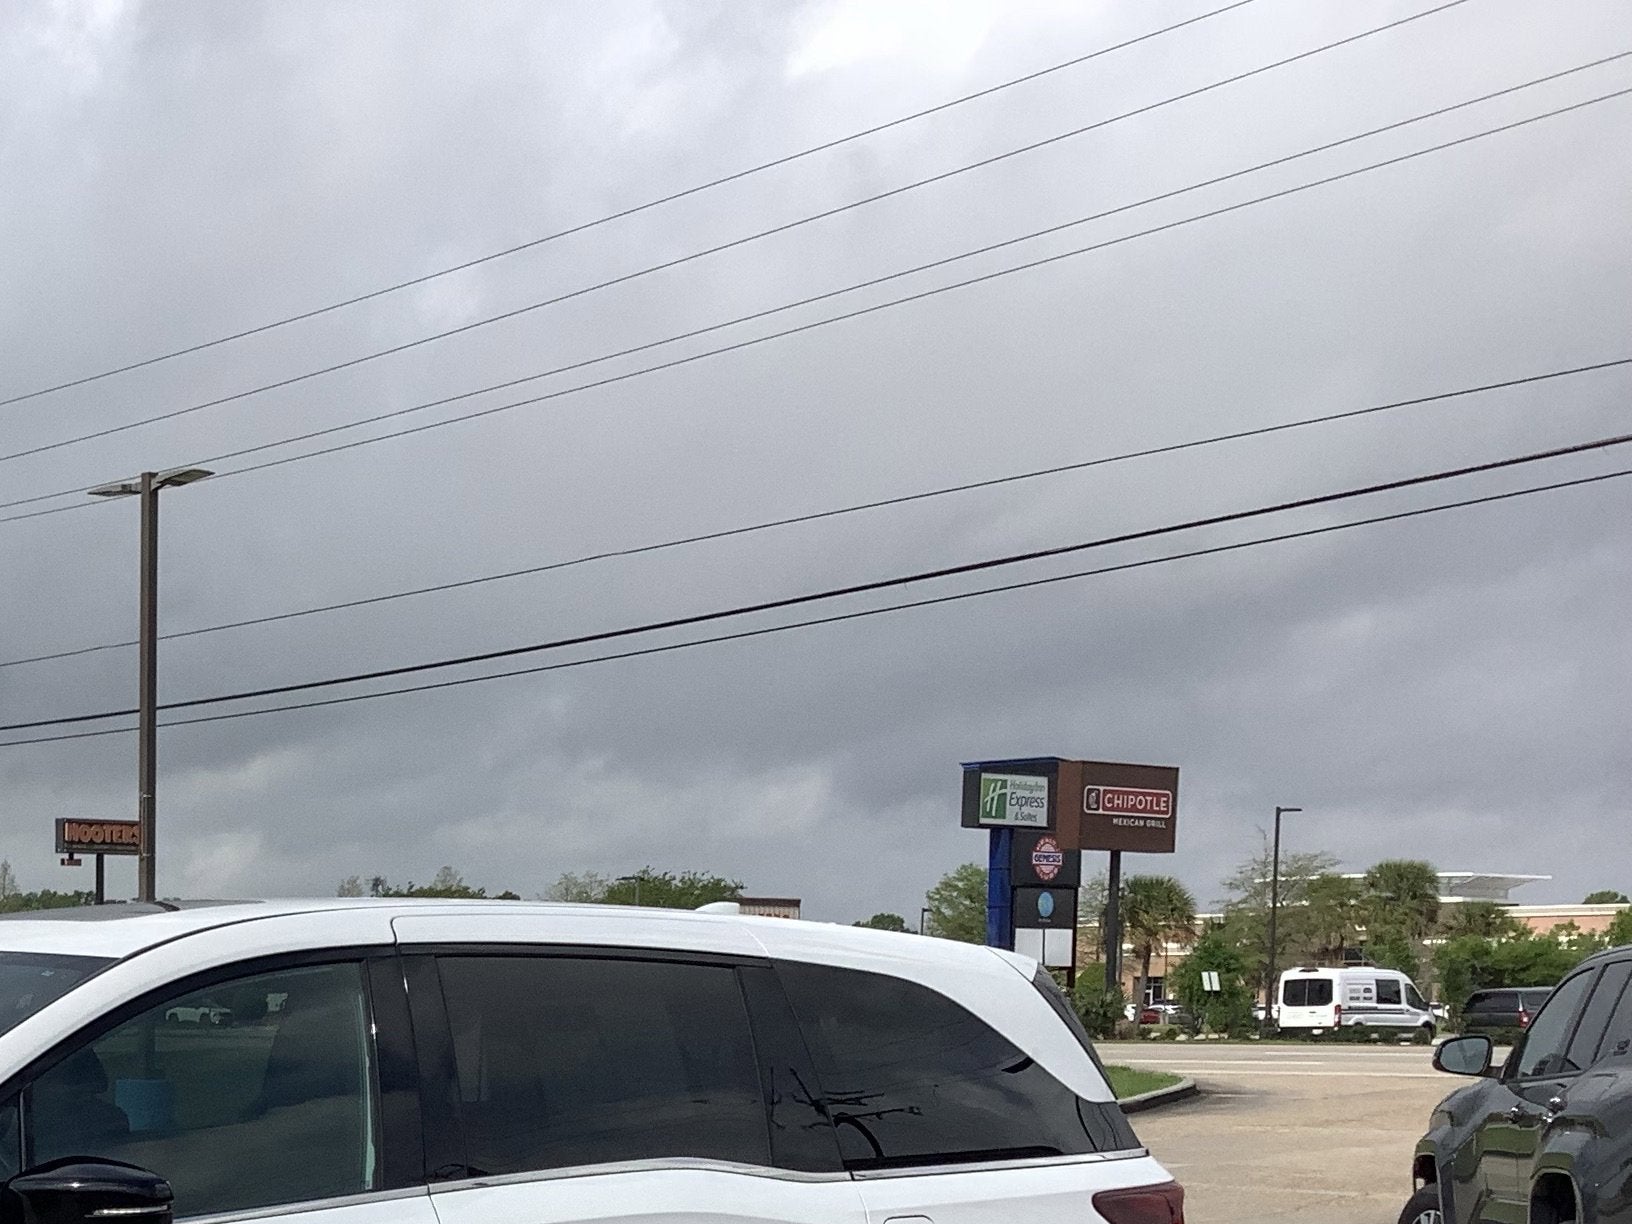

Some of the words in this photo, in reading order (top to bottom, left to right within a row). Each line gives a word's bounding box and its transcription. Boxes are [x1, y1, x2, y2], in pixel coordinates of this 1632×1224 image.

[1009, 791, 1045, 810] Express
[1104, 793, 1168, 811] CHIPOTLE
[1113, 818, 1144, 827] MEXICAN
[1146, 820, 1167, 829] GRILL
[64, 822, 139, 844] HOOTERS
